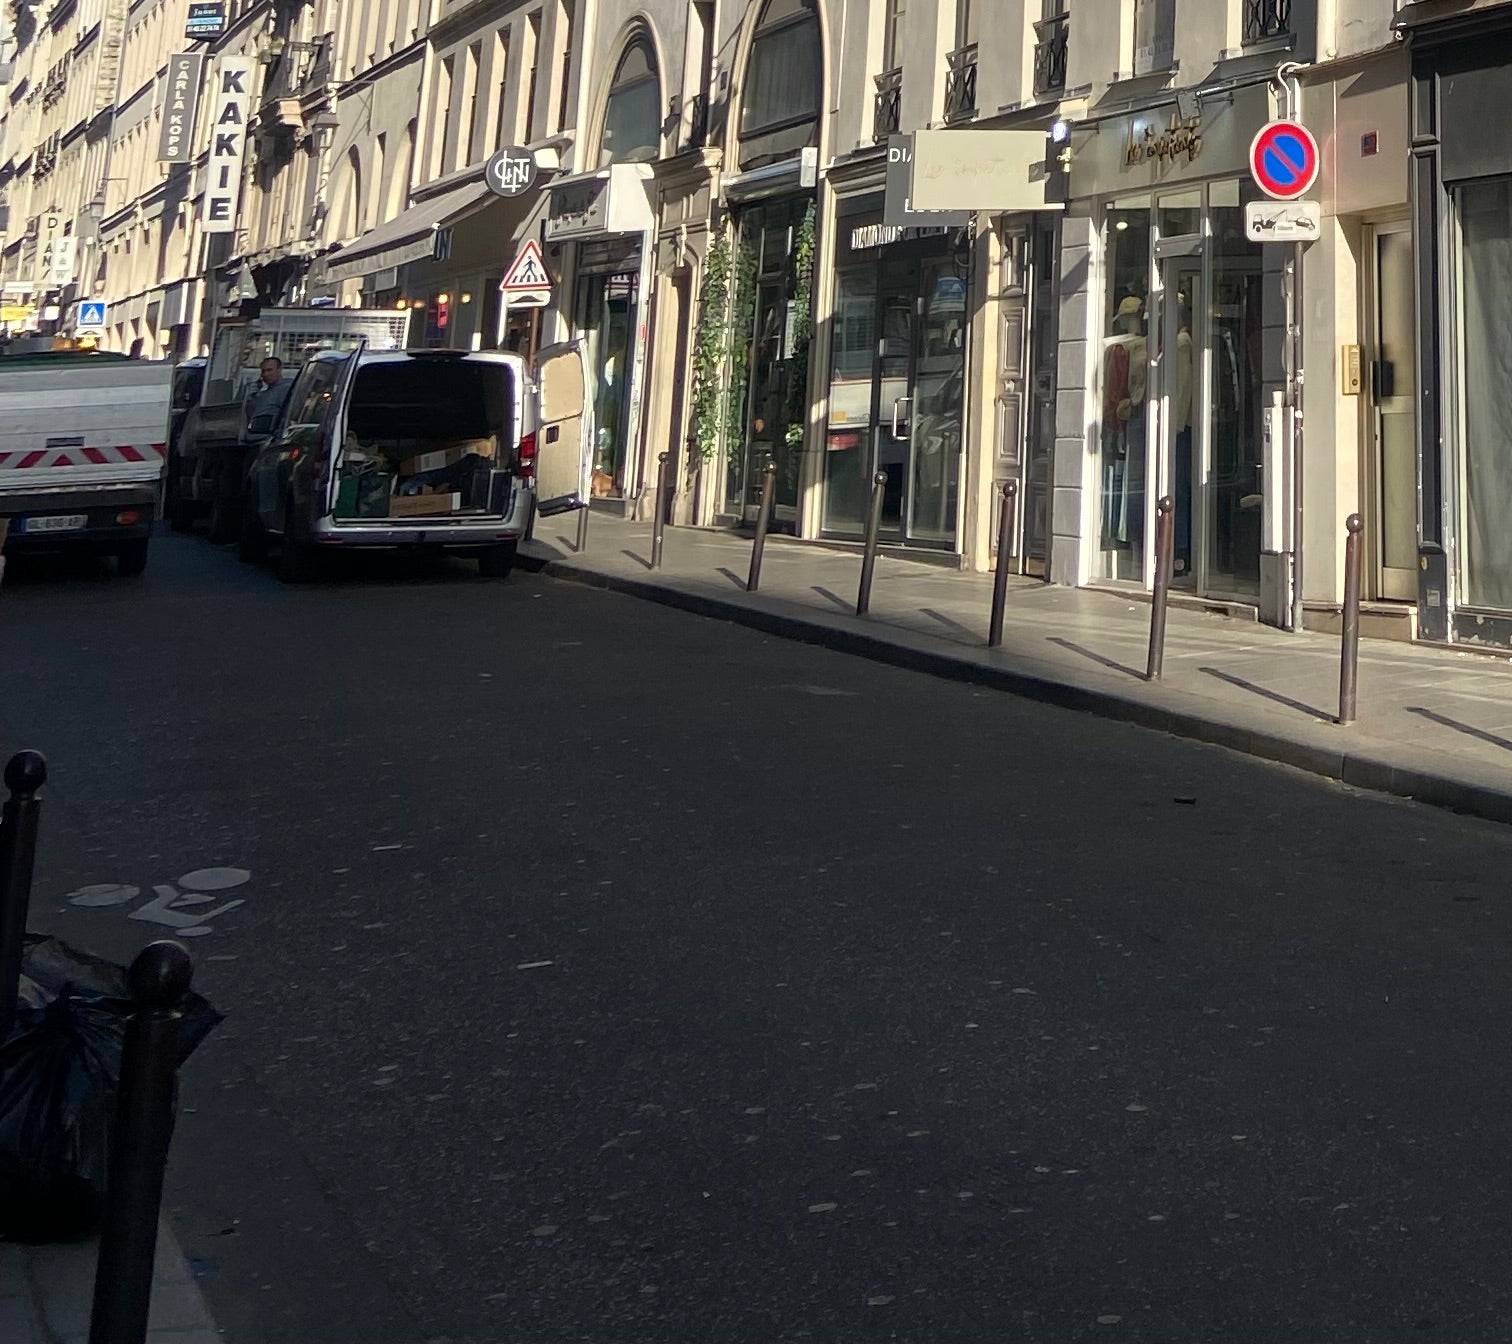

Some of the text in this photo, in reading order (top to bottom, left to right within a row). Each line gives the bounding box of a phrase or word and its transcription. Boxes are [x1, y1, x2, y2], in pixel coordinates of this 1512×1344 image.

[166, 60, 190, 157] CARLA KOPS
[209, 70, 246, 221] KAKIE
